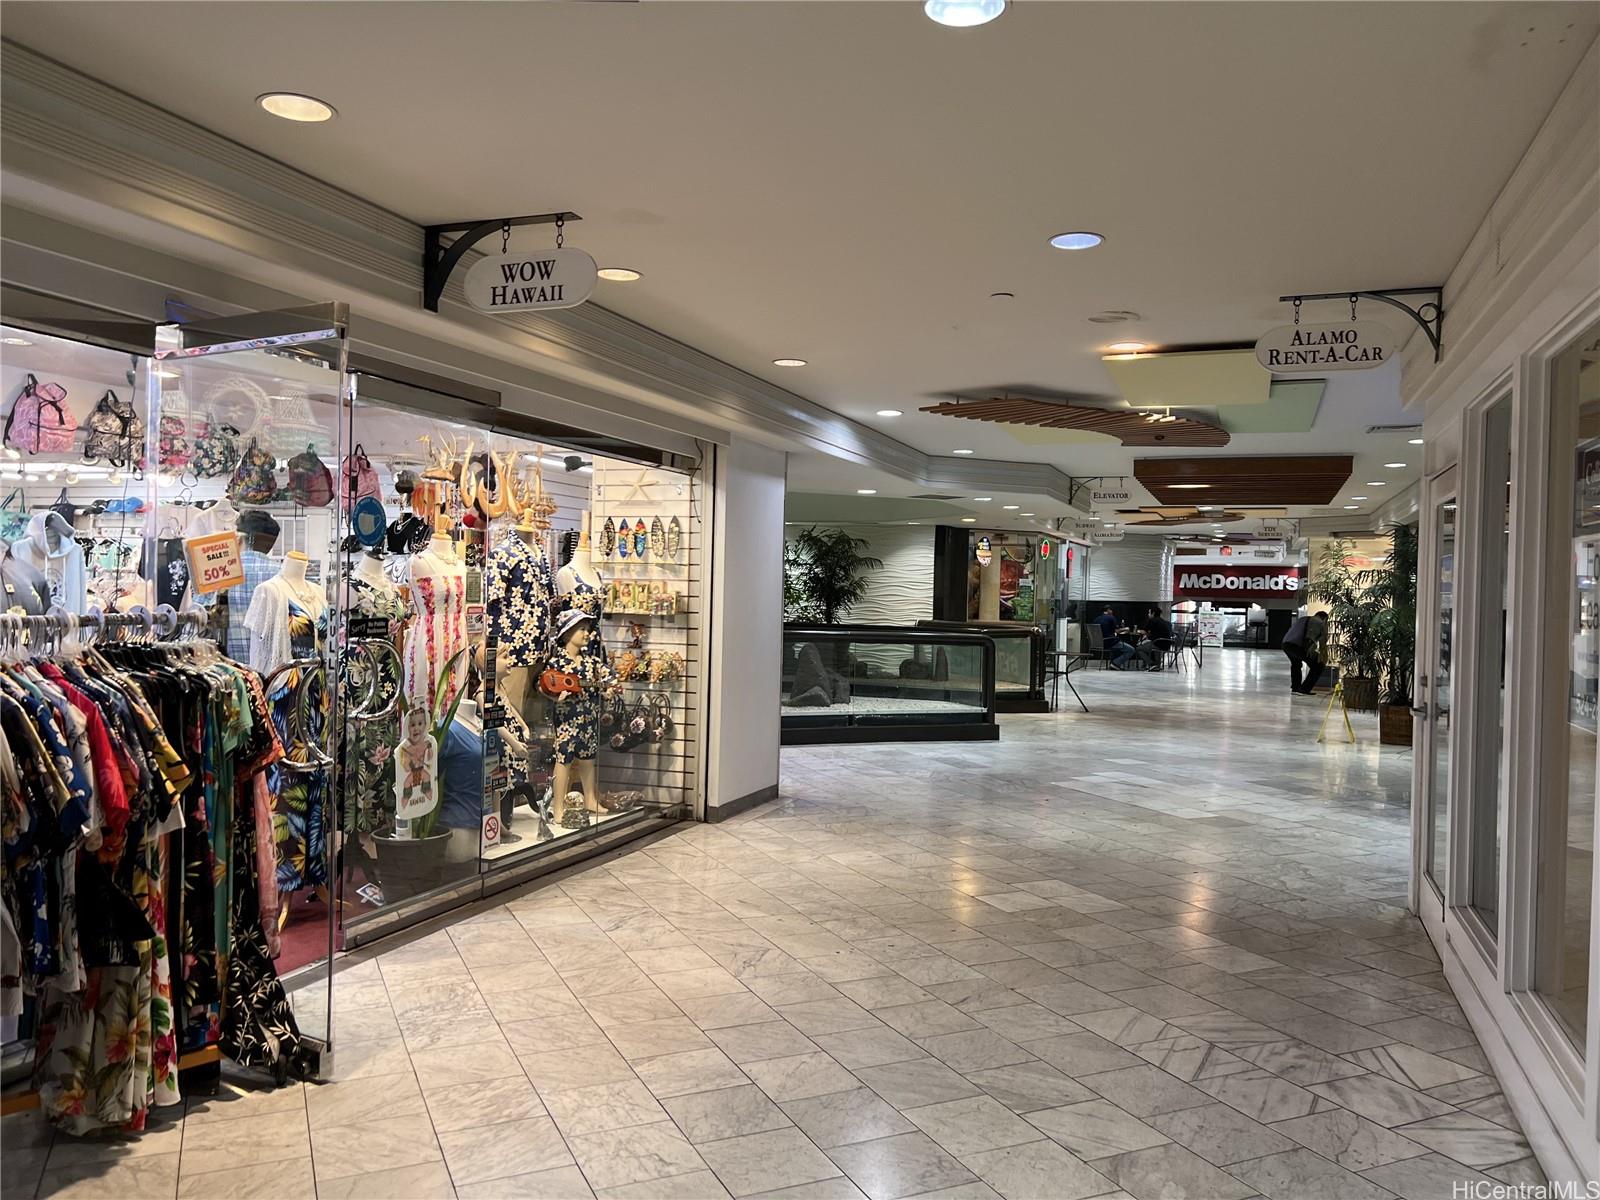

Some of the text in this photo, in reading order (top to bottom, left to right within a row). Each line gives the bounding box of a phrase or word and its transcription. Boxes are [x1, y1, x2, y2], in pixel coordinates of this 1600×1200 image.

[500, 259, 556, 284] WOW
[490, 284, 563, 306] HAWAII
[1290, 329, 1358, 347] ALAMO
[1267, 345, 1384, 366] RENT-A-CAR
[1093, 491, 1129, 499] ELEVATOR
[201, 542, 230, 554] SPECIAL
[204, 558, 237, 581] 50% OFF
[1179, 573, 1299, 591] McDonald's
[328, 608, 337, 670] PULL
